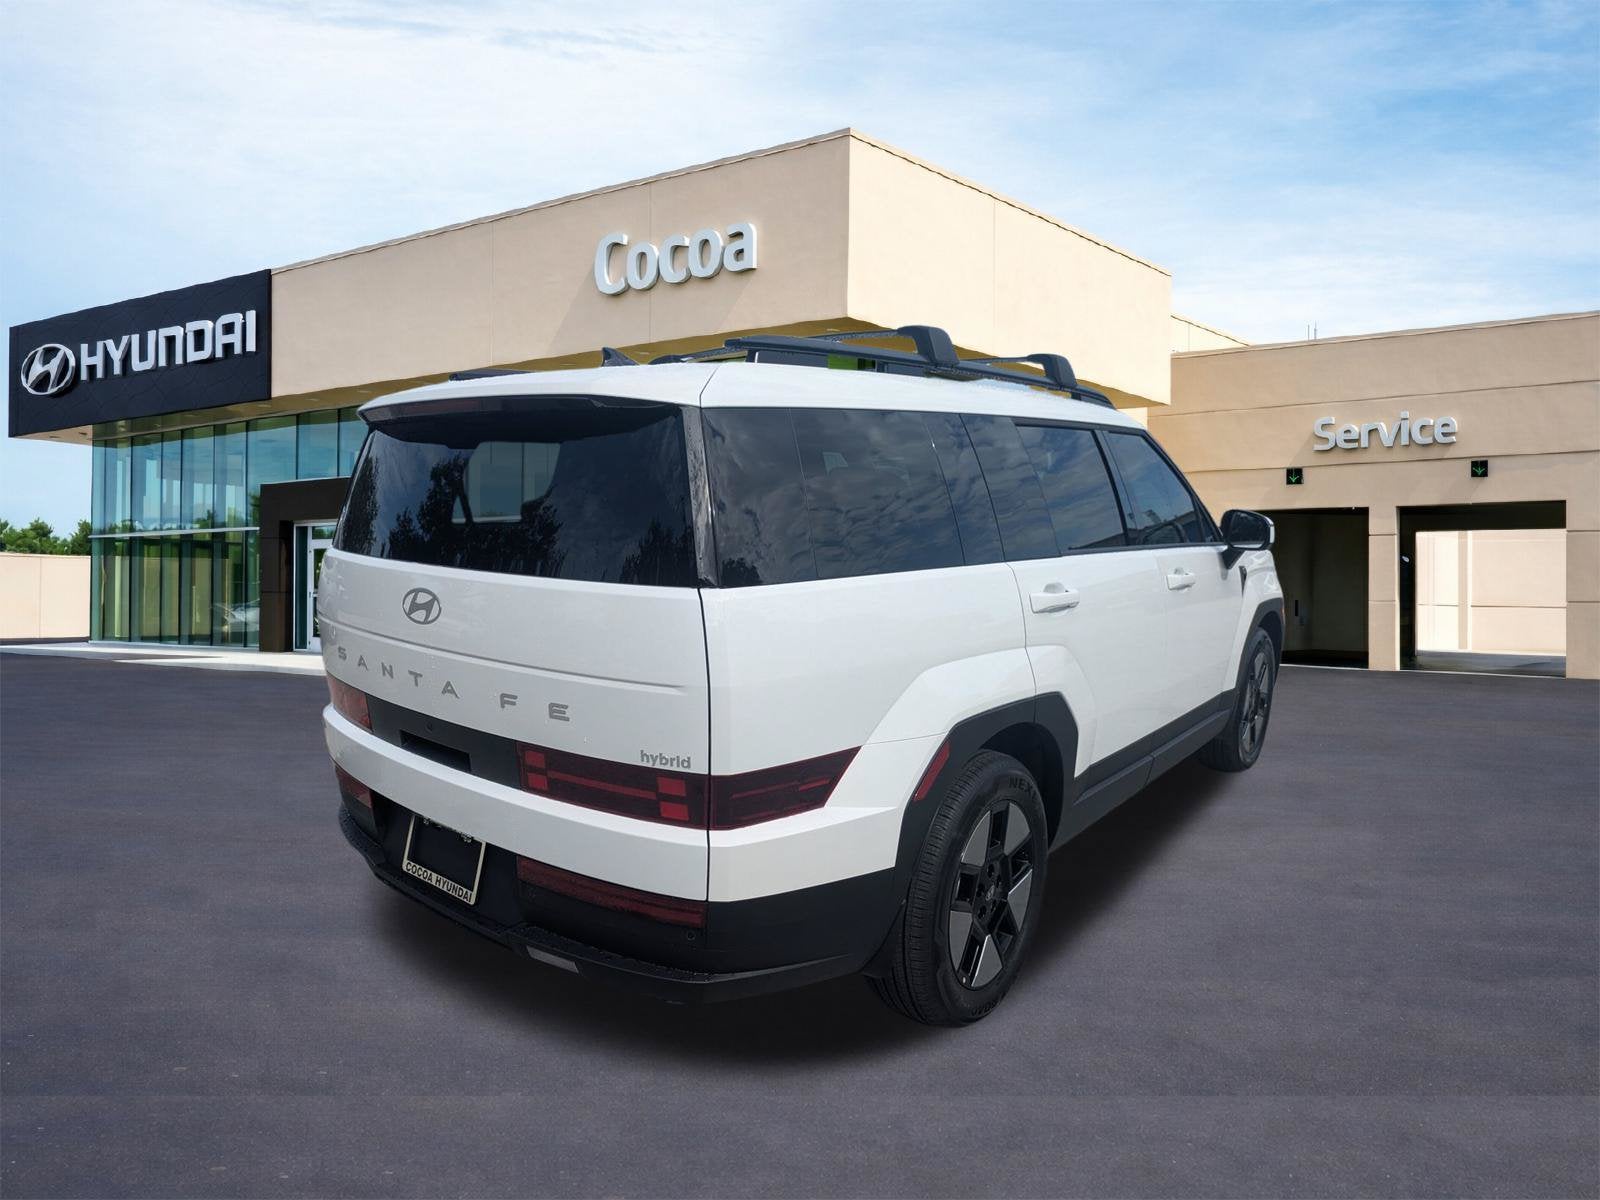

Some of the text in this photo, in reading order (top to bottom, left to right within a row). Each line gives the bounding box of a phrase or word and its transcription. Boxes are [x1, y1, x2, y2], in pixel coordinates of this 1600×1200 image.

[593, 222, 758, 296] Cocoa
[80, 310, 257, 381] HYUNDAI
[1313, 410, 1458, 451] Service
[337, 645, 570, 722] SANTA FE
[640, 749, 692, 769] hybrid
[405, 861, 473, 903] COCOA HYUNDAI
